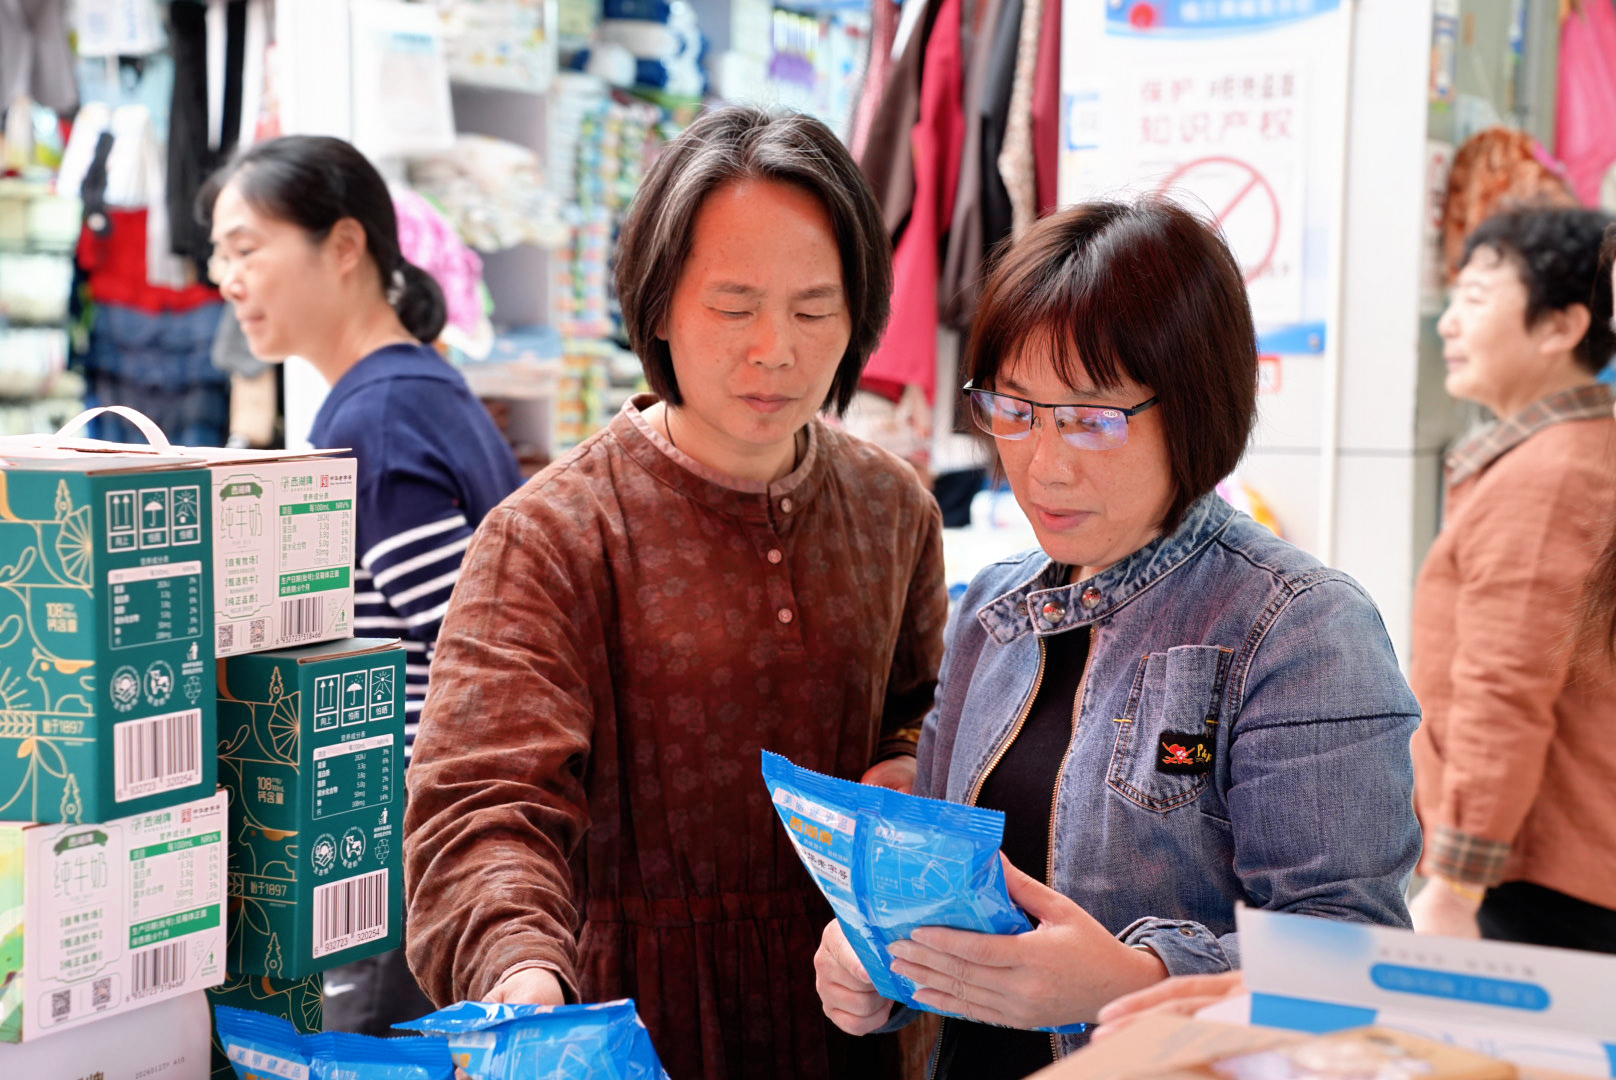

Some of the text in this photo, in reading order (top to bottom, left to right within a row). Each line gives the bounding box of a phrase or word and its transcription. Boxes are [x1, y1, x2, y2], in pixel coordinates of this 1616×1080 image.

[1139, 109, 1294, 144] 知识产权
[220, 504, 263, 540] 纯牛奶
[320, 716, 333, 727] 向上
[257, 776, 272, 791] 108
[257, 791, 285, 805] 钙含量
[54, 852, 108, 898] 纯牛奶
[802, 851, 848, 880] 华老字号
[250, 881, 288, 897] 始于1897
[314, 928, 380, 956] 6 932723 320254
